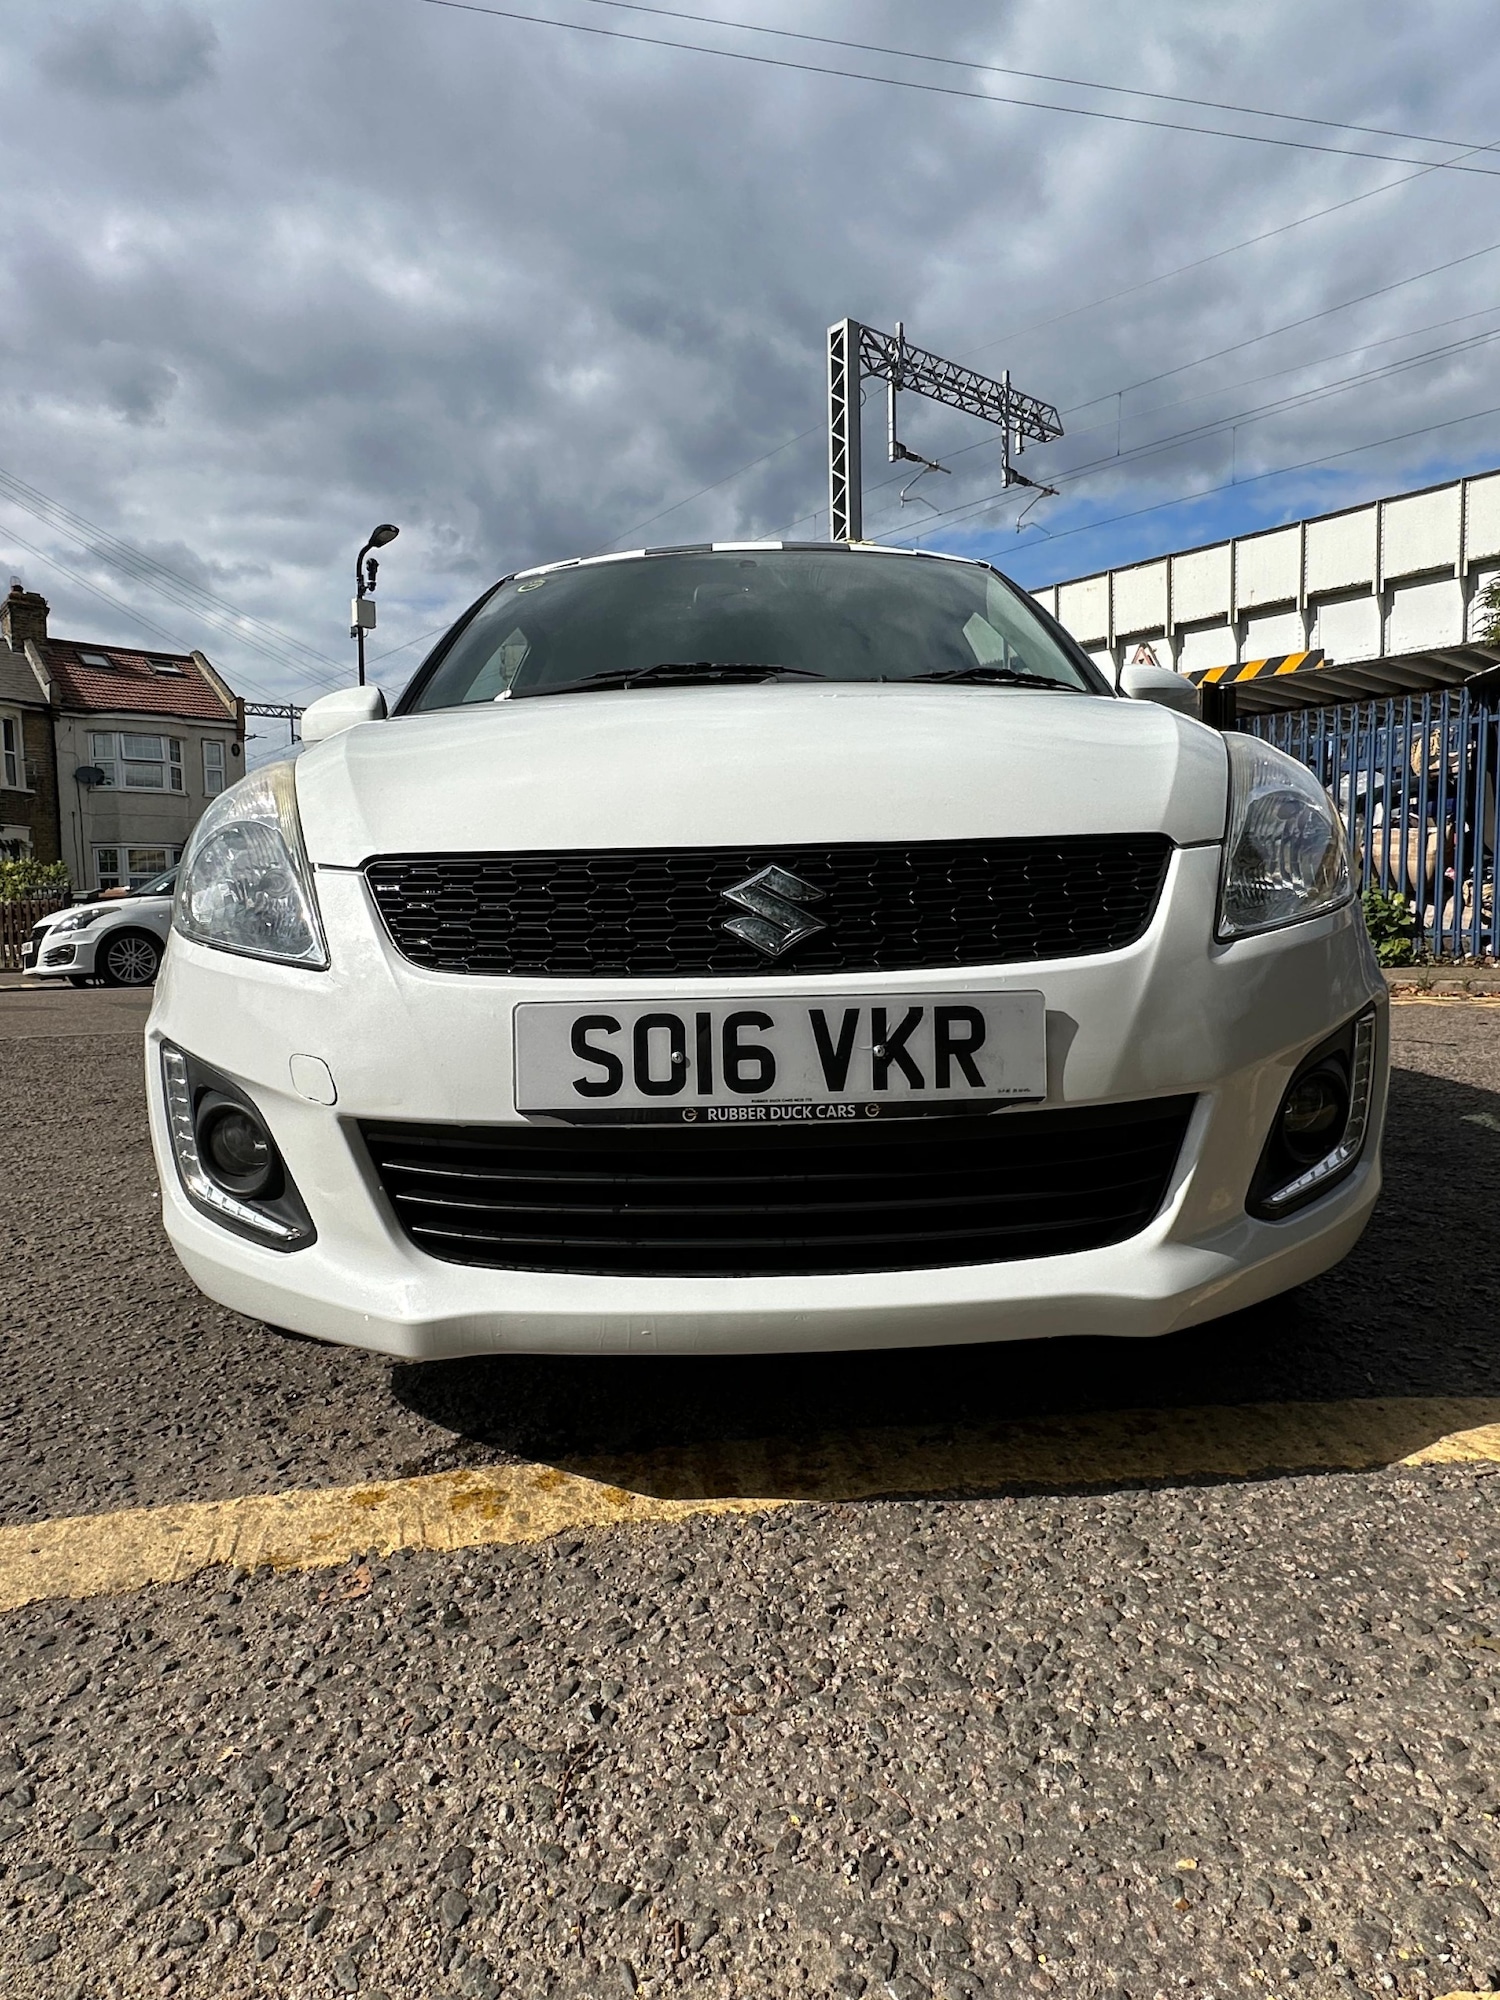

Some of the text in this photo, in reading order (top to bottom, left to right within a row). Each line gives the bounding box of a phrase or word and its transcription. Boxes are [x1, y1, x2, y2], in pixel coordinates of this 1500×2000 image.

[570, 1005, 987, 1098] SO16 VKR
[707, 1104, 856, 1121] RUBBER DUCK CARS
